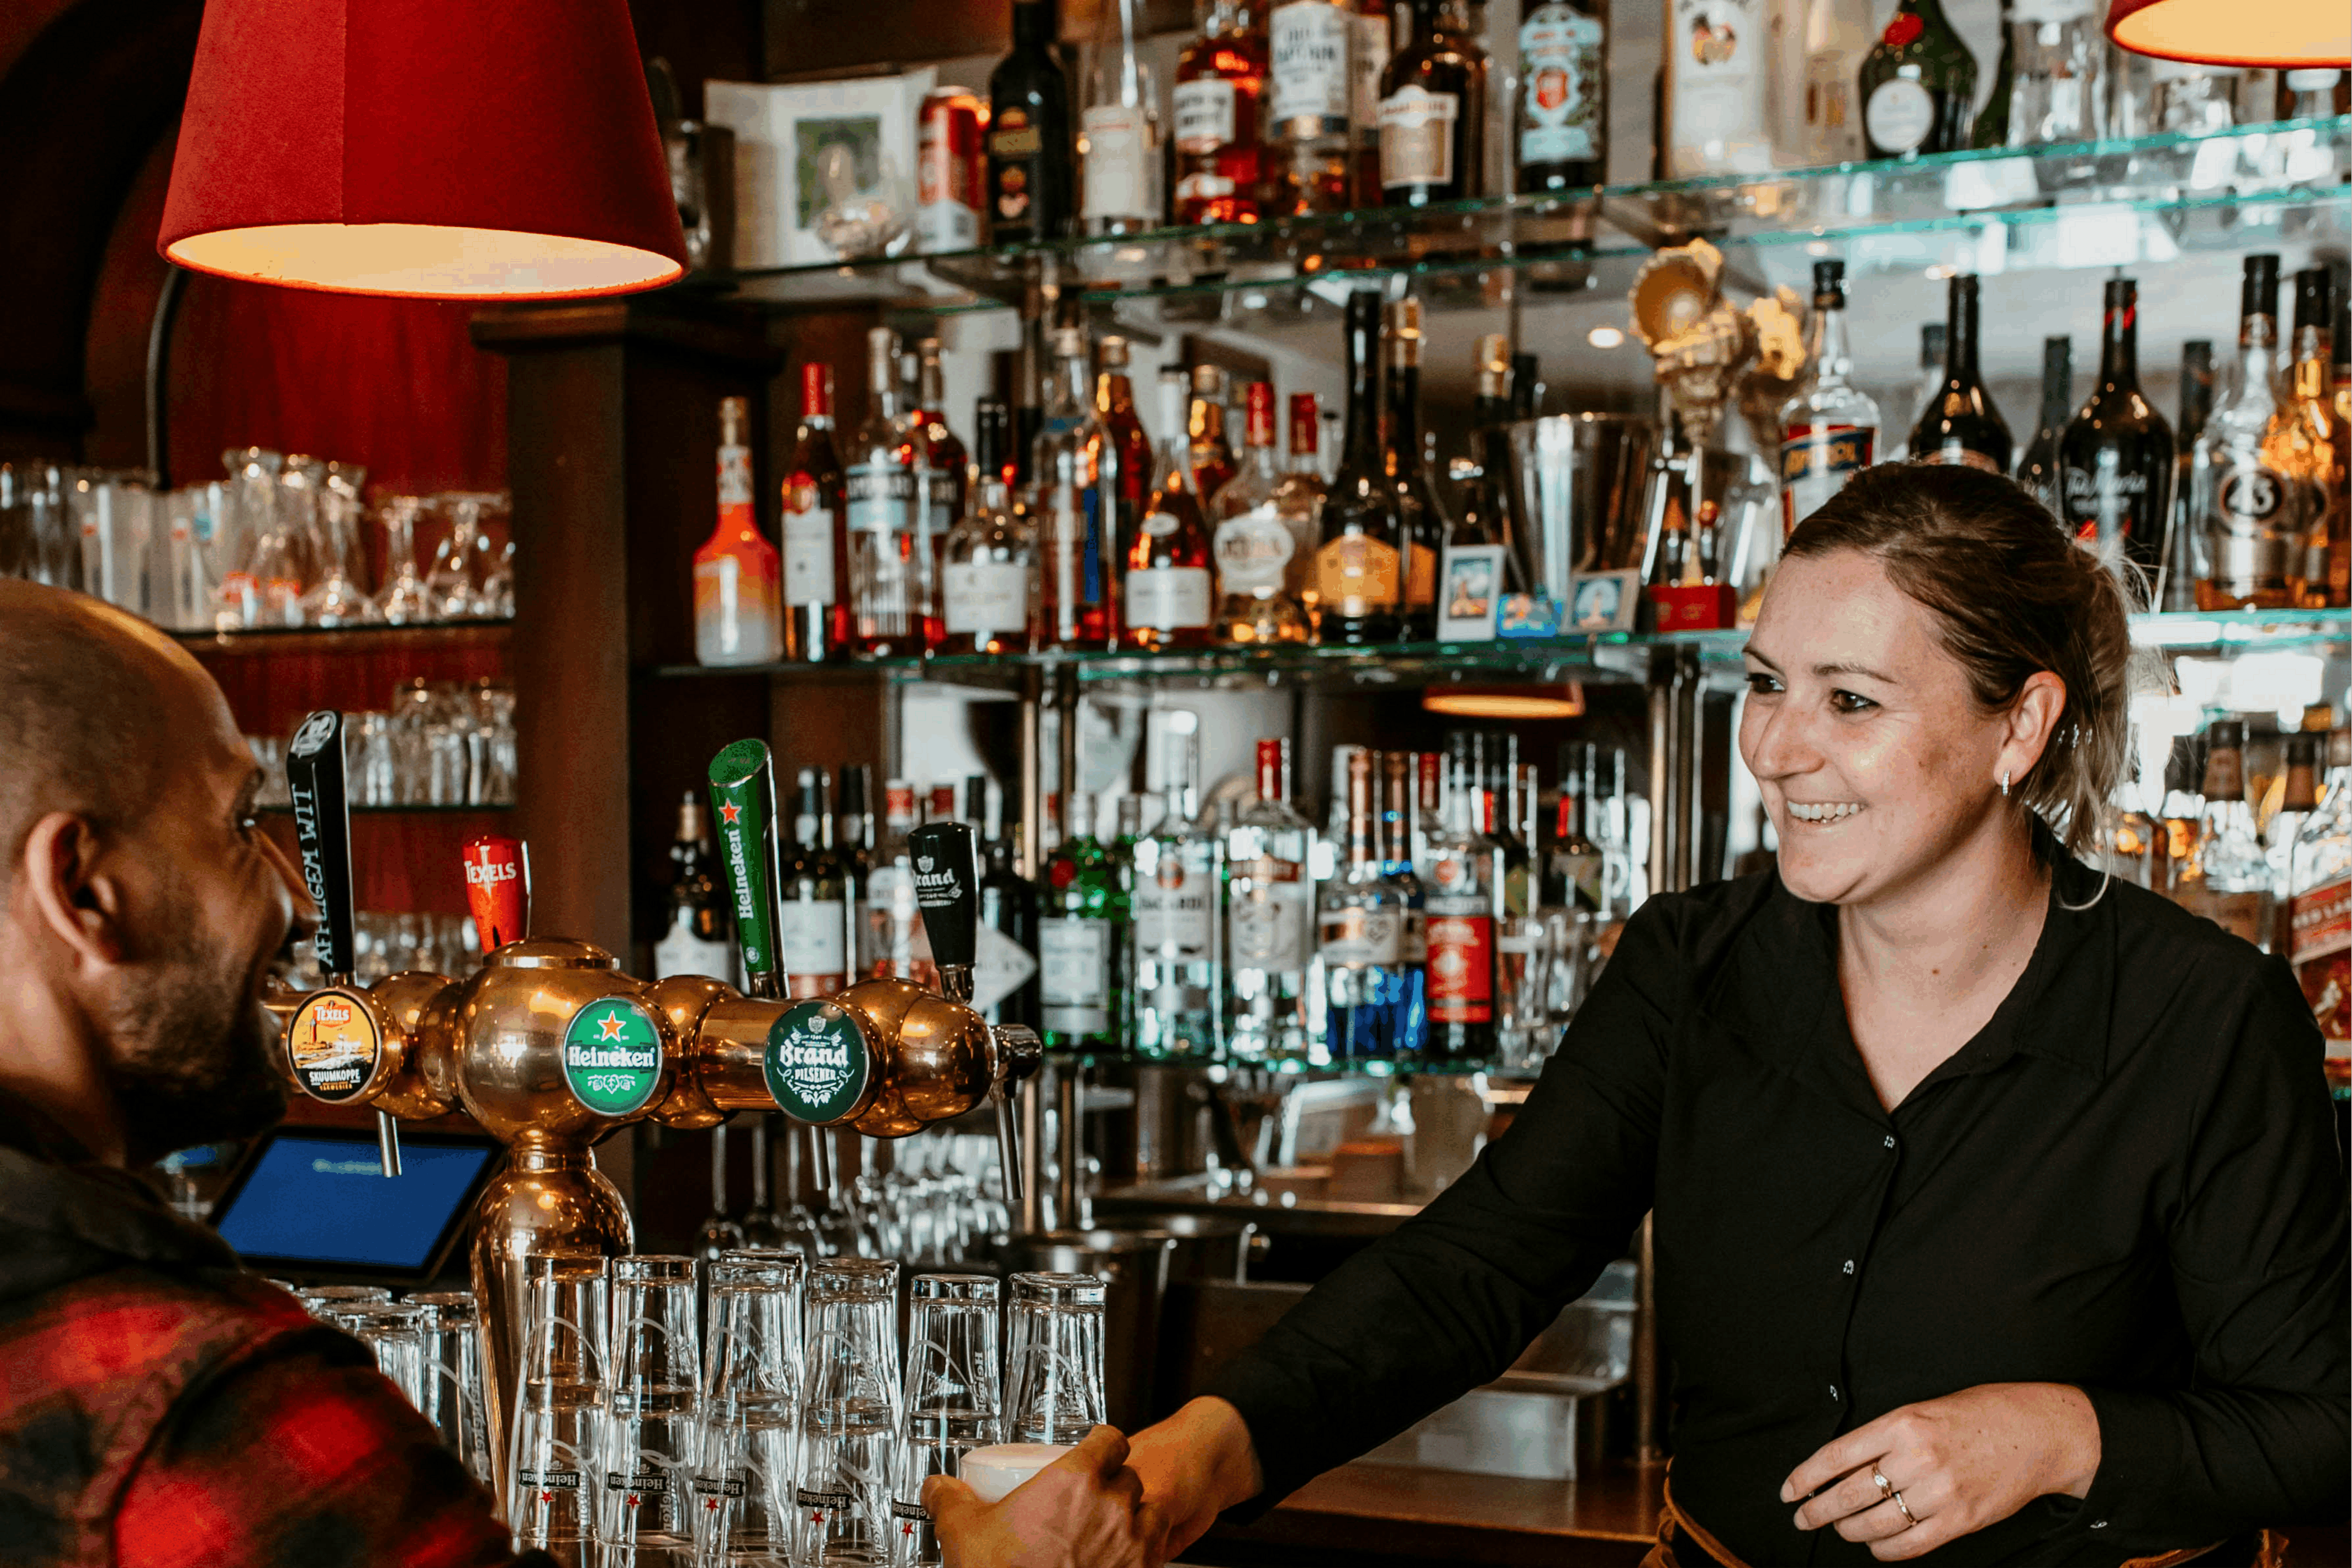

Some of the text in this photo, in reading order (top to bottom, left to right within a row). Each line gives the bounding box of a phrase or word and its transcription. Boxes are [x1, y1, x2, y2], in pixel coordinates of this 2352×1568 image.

[292, 783, 317, 841] WIT
[464, 860, 516, 883] TEXELS
[728, 829, 753, 919] Heineken
[315, 1005, 349, 1021] TEXELS
[569, 1046, 655, 1067] Heineken
[780, 1039, 850, 1068] Brand
[309, 1069, 360, 1082] SKUUMKOPPE
[795, 1067, 837, 1083] PILSENER
[798, 1493, 847, 1508] Heineken
[894, 1504, 930, 1519] eineken
